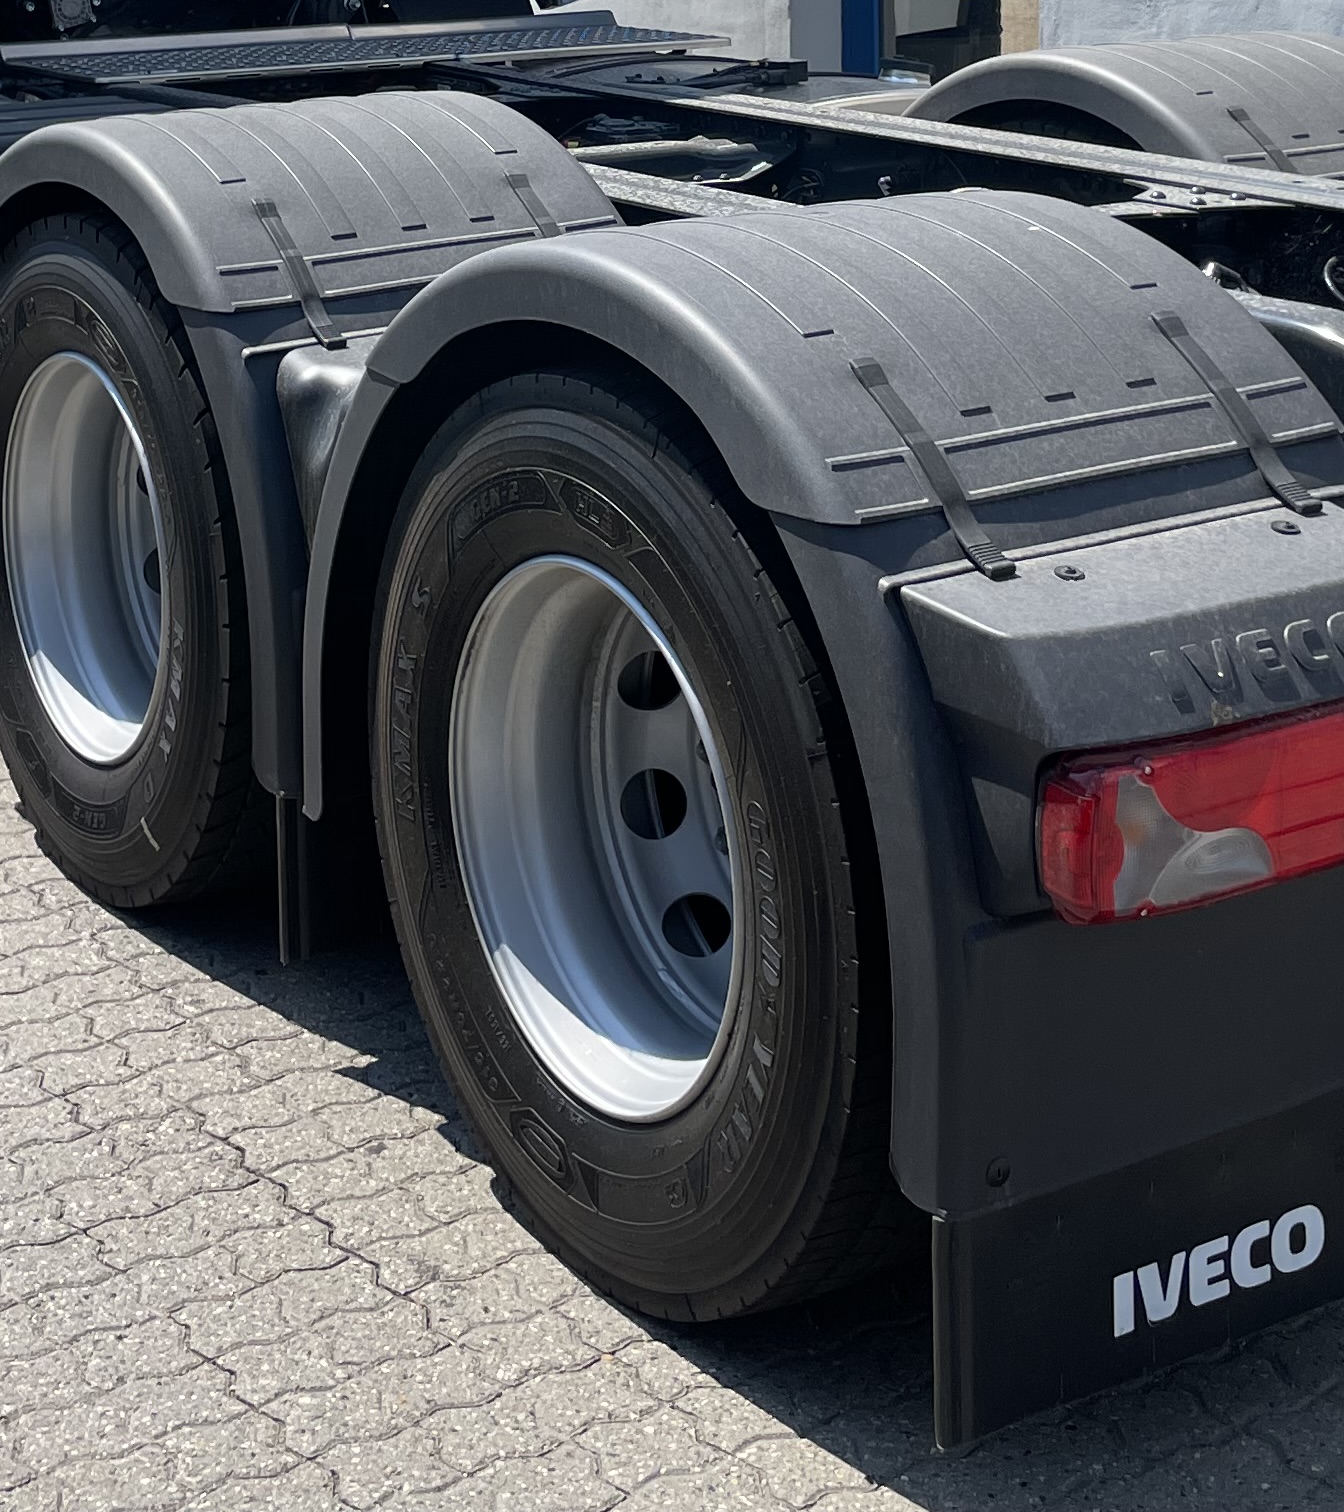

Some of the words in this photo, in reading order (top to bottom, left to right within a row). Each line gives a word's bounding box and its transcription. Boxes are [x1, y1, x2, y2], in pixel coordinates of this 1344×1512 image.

[158, 617, 185, 765] KMAX
[392, 641, 418, 823] KMAX
[1113, 1204, 1325, 1338] IVECO
